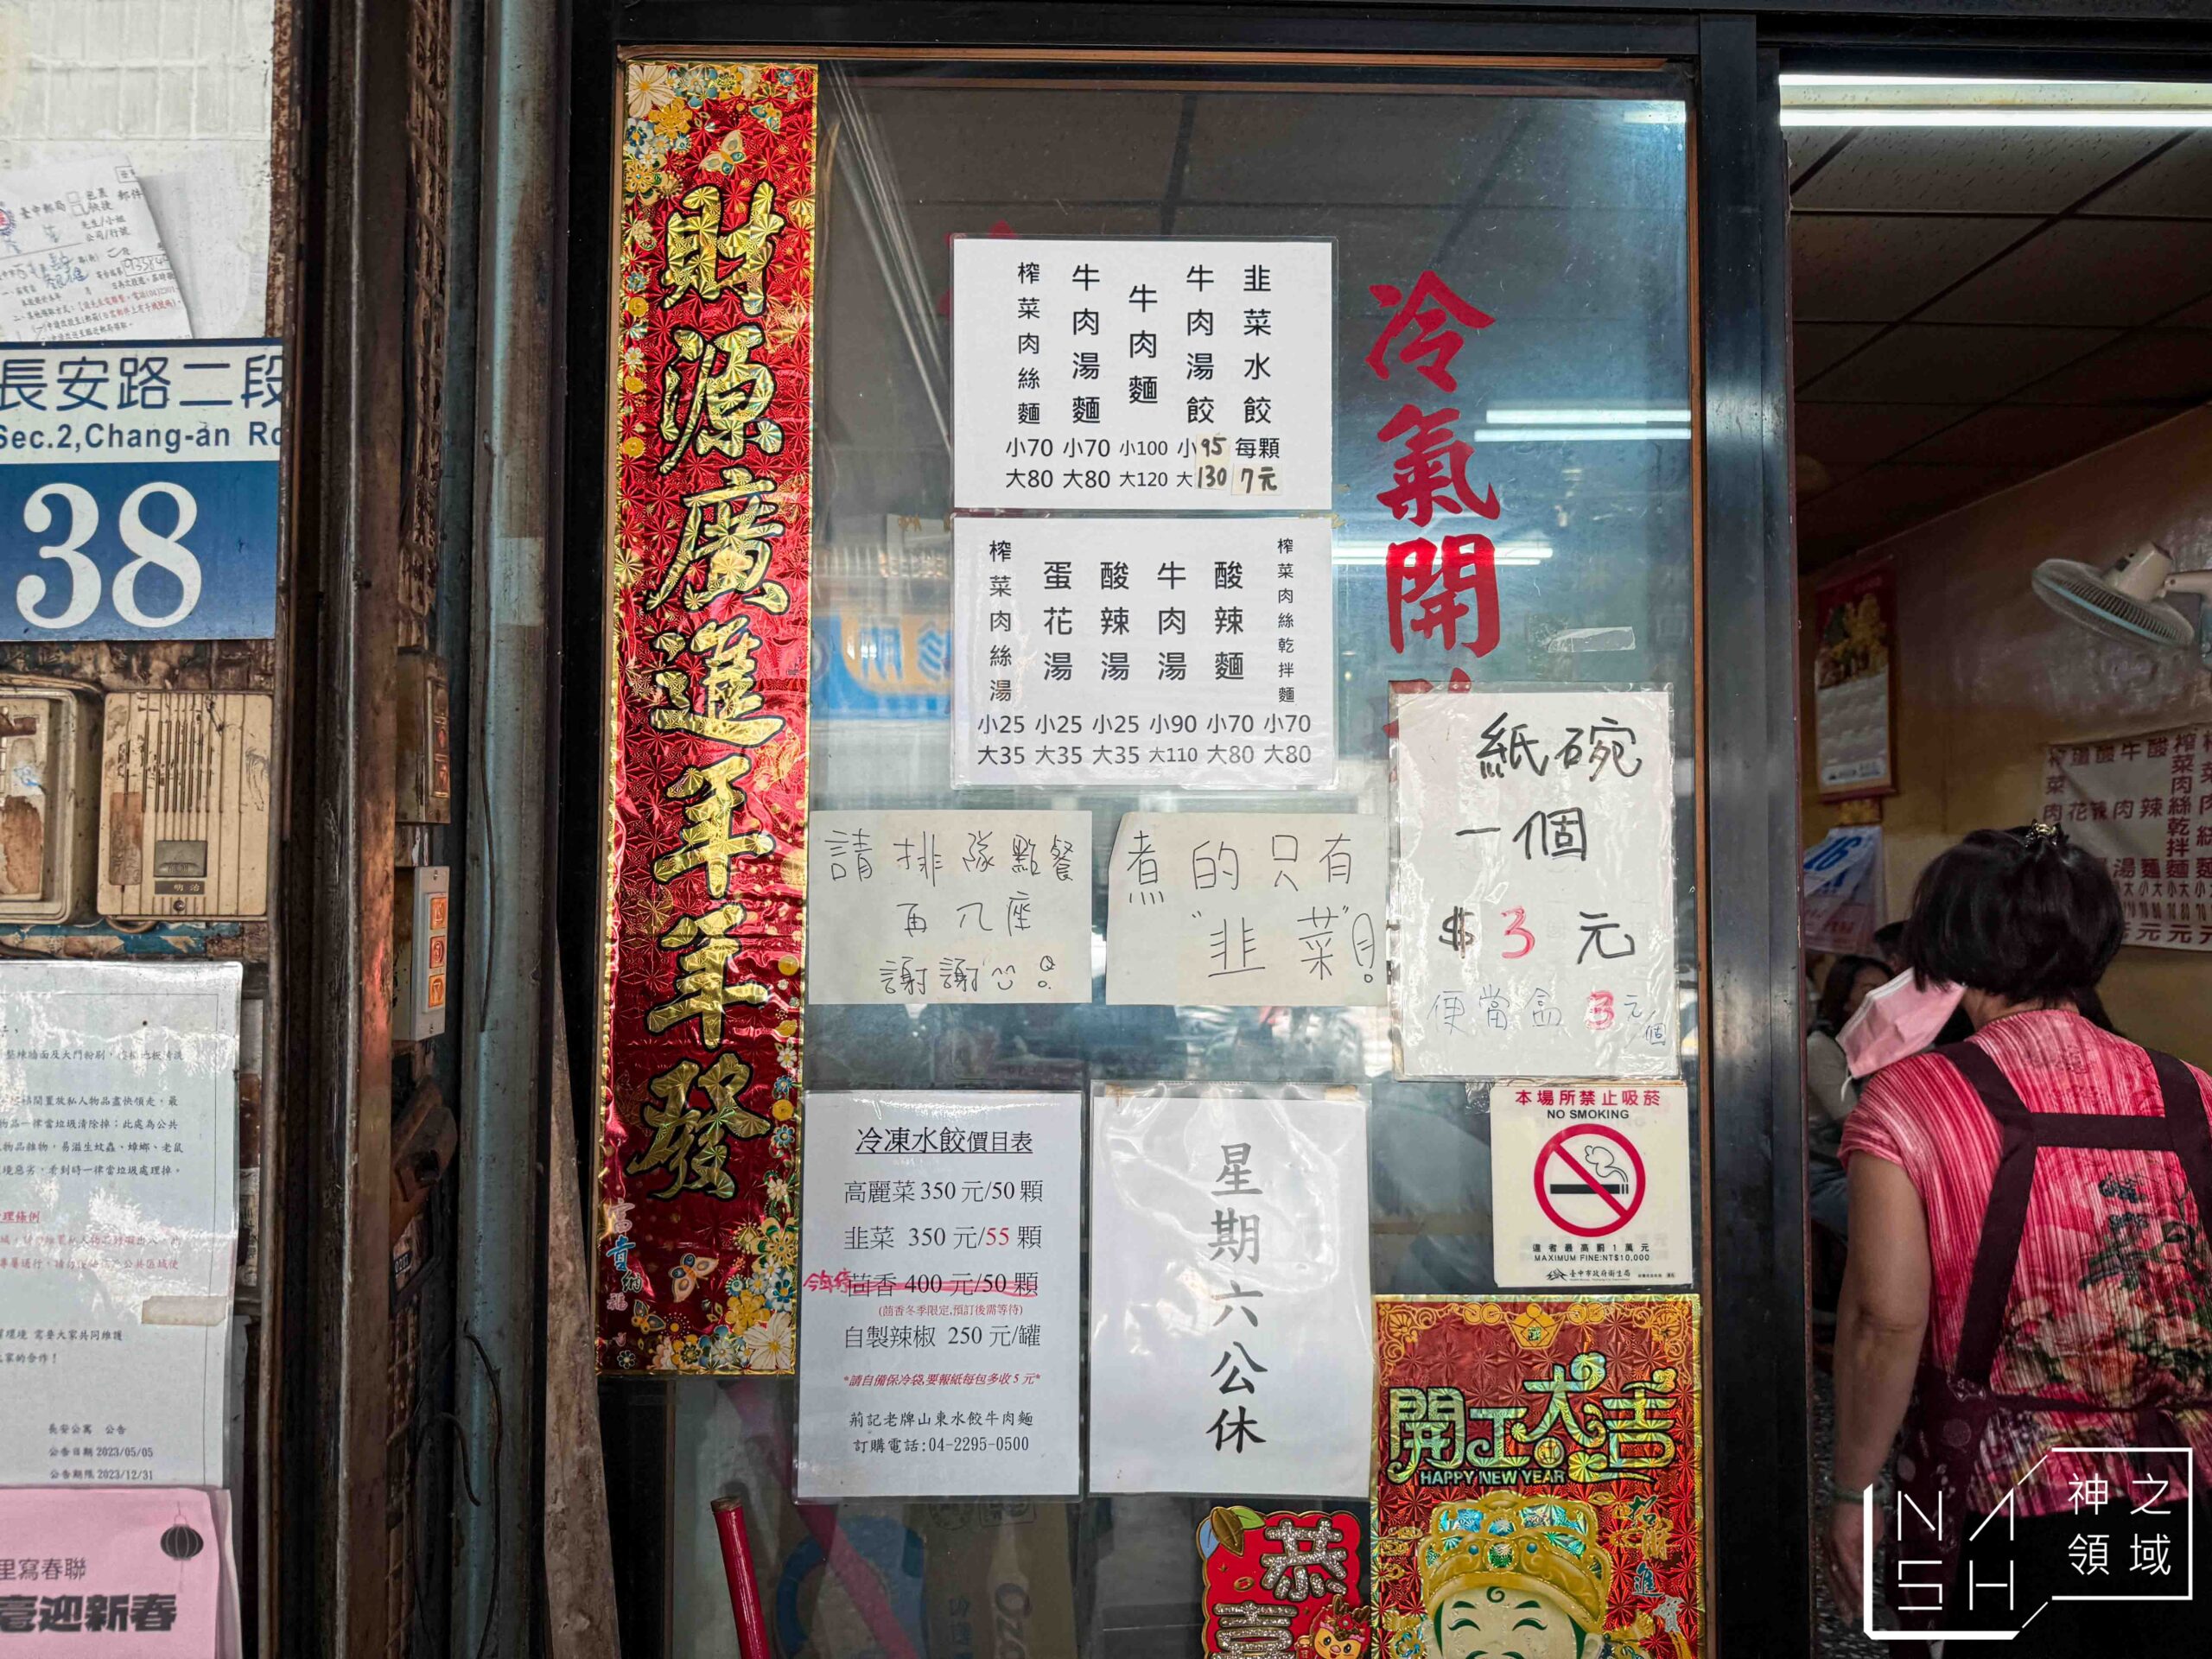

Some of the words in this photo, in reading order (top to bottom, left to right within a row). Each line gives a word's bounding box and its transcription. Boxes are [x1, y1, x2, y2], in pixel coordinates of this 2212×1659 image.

[0, 355, 283, 411] 長安路二段
[1017, 262, 1040, 425] 榨菜肉絲麵
[1071, 264, 1101, 424] 牛肉湯麵
[1128, 283, 1159, 405] 牛肉麵
[1186, 264, 1215, 424] 牛肉湯餃
[1243, 264, 1272, 424] 韭菜水餃
[1005, 437, 1053, 459] 小70
[1062, 437, 1110, 459] 小70
[1119, 439, 1168, 457] 小100
[1235, 437, 1281, 459] 每顆
[1005, 468, 1053, 489] 大80
[1062, 468, 1110, 489] 大80
[1119, 471, 1168, 488] 大120
[1364, 270, 1501, 691] 冷氣開
[16, 481, 201, 629] 38
[988, 540, 1013, 702] 榨菜肉絲湯
[1043, 561, 1073, 682] 蛋花湯
[1100, 561, 1130, 682] 酸辣湯
[1157, 561, 1187, 682] 牛肉湯
[1214, 561, 1244, 681] 酸辣麵
[1277, 537, 1295, 703] 榨菜肉絲乾拌麵
[977, 714, 1025, 734] 小25
[1034, 714, 1083, 734] 小25
[1092, 714, 1140, 734] 小25
[1149, 714, 1198, 734] 小90
[1206, 714, 1255, 734] 小70
[1263, 714, 1312, 734] 小70
[977, 745, 1025, 766] 大35
[1034, 745, 1083, 766] 大35
[1092, 745, 1140, 766] 大35
[1149, 745, 1198, 766] 大110
[1206, 745, 1255, 766] 大80
[1263, 745, 1312, 766] 大80
[1476, 712, 1642, 781] 紙碗
[1455, 806, 1587, 862] 一個
[855, 1126, 1033, 1154] 冷凍水餃價目表
[1515, 1090, 1661, 1106] 本場所禁止吸菸
[1547, 1109, 1566, 1119] NO
[1569, 1109, 1630, 1119] SMOKING
[0, 1210, 41, 1224] 理條例
[843, 1225, 895, 1250] 韭菜
[843, 1325, 936, 1349] 自製辣椒
[1205, 1141, 1268, 1454] 星期六公休
[1387, 1351, 1679, 1486] 開工大吉
[1420, 1469, 1474, 1486] HAPPY
[1478, 1469, 1516, 1486] NEW
[1519, 1469, 1566, 1485] YEAR
